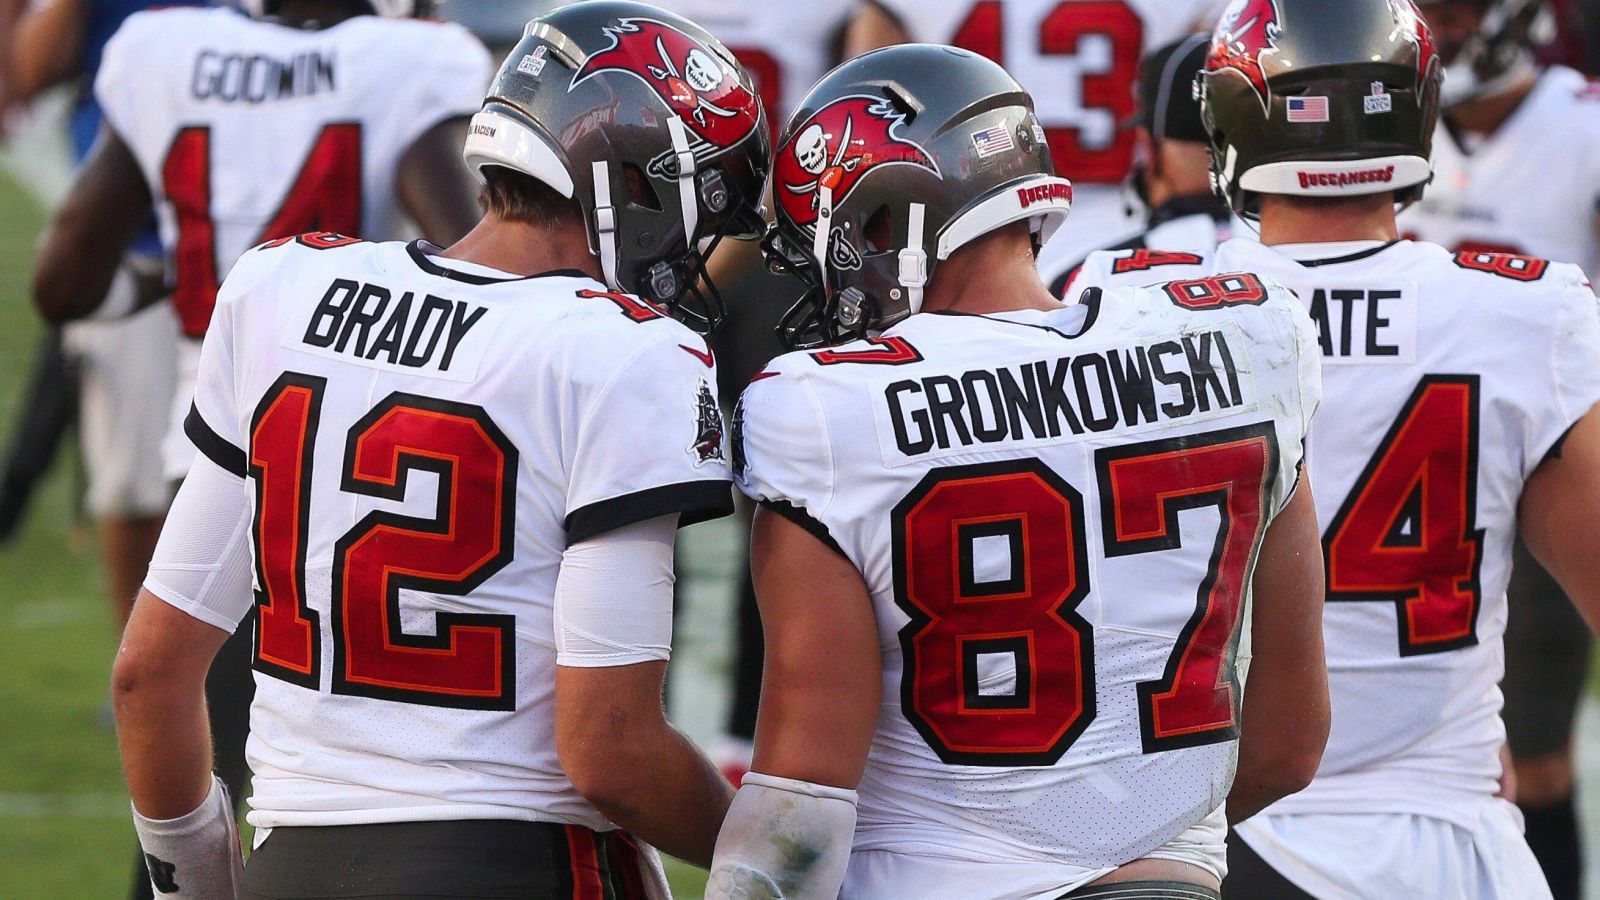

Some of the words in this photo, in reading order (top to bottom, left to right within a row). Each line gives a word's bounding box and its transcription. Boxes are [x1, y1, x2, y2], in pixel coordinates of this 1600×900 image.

[191, 48, 337, 101] GODWIN
[519, 61, 541, 74] CATCH
[161, 121, 364, 338] 14
[1298, 165, 1394, 189] BUCCANEERS
[303, 279, 487, 372] BRADY
[1162, 272, 1268, 311] 8
[885, 331, 1243, 456] GRONKOWSKI
[248, 371, 518, 711] 12
[1322, 374, 1484, 656] 4
[891, 420, 1278, 766] 87
